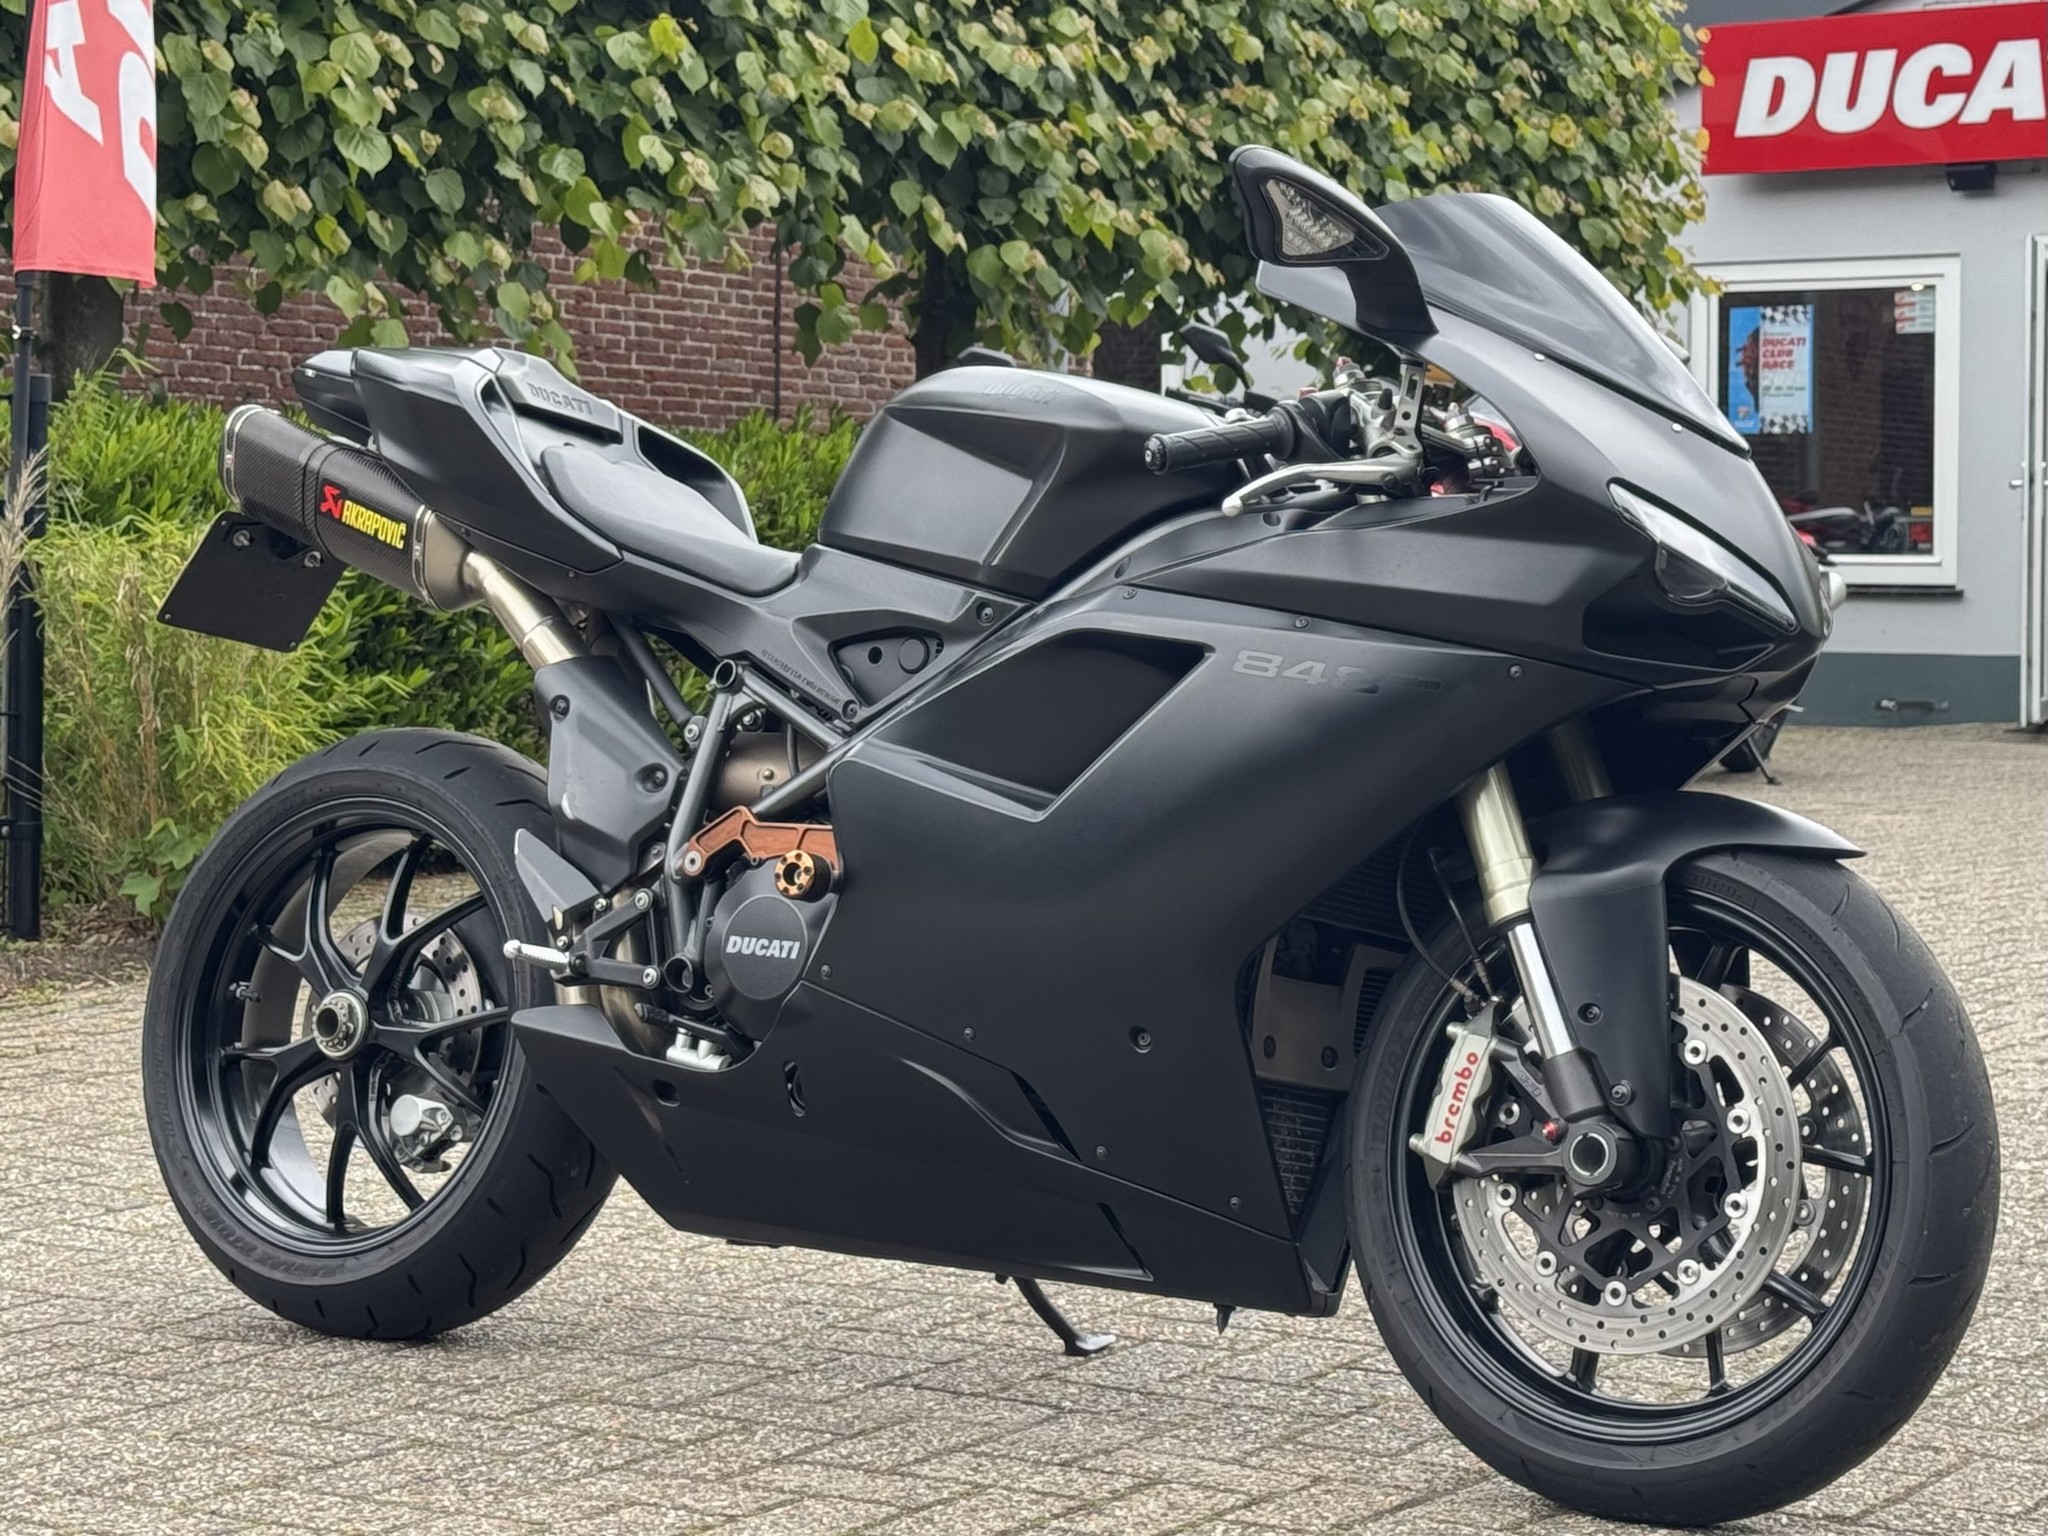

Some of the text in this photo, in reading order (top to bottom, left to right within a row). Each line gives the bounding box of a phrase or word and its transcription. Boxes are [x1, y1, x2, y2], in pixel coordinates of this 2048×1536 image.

[1734, 38, 2046, 138] DUCA
[1762, 336, 1806, 347] DUCATI
[1762, 348, 1793, 358] CLUB
[1762, 359, 1794, 370] RACE
[526, 381, 593, 416] DUCATI
[725, 935, 801, 959] DUCATI
[1435, 1052, 1479, 1144] brembo
